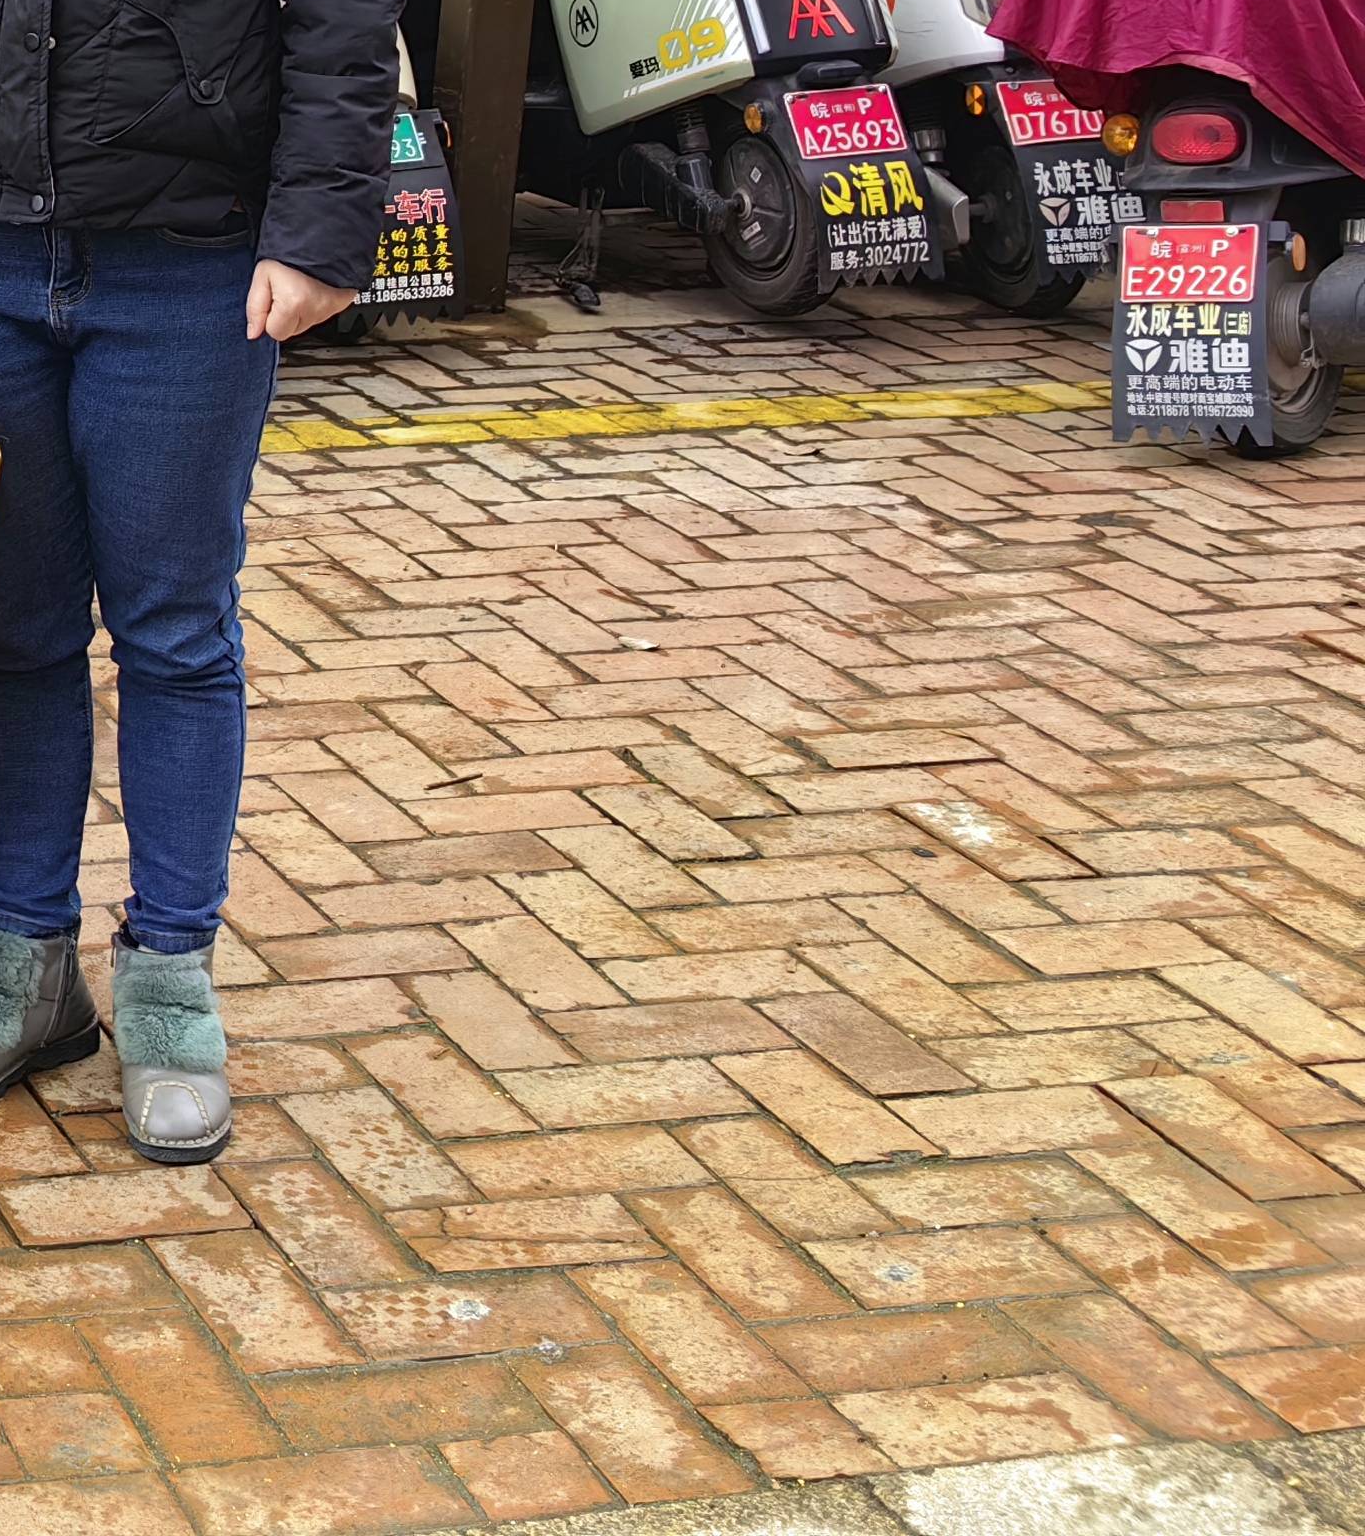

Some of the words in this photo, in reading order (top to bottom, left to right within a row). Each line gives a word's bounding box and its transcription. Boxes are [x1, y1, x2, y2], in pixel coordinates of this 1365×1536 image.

[629, 57, 660, 79] 爱玛
[656, 17, 726, 69] 09
[803, 118, 901, 155] A25693
[1074, 192, 1146, 226] 雅迪
[827, 215, 926, 247] (让出行充满爱)
[830, 241, 930, 271] 服务:3024772
[1126, 265, 1247, 297] E29226
[1168, 338, 1252, 374] 雅迪
[1126, 374, 1253, 392] 更高端的电动车
